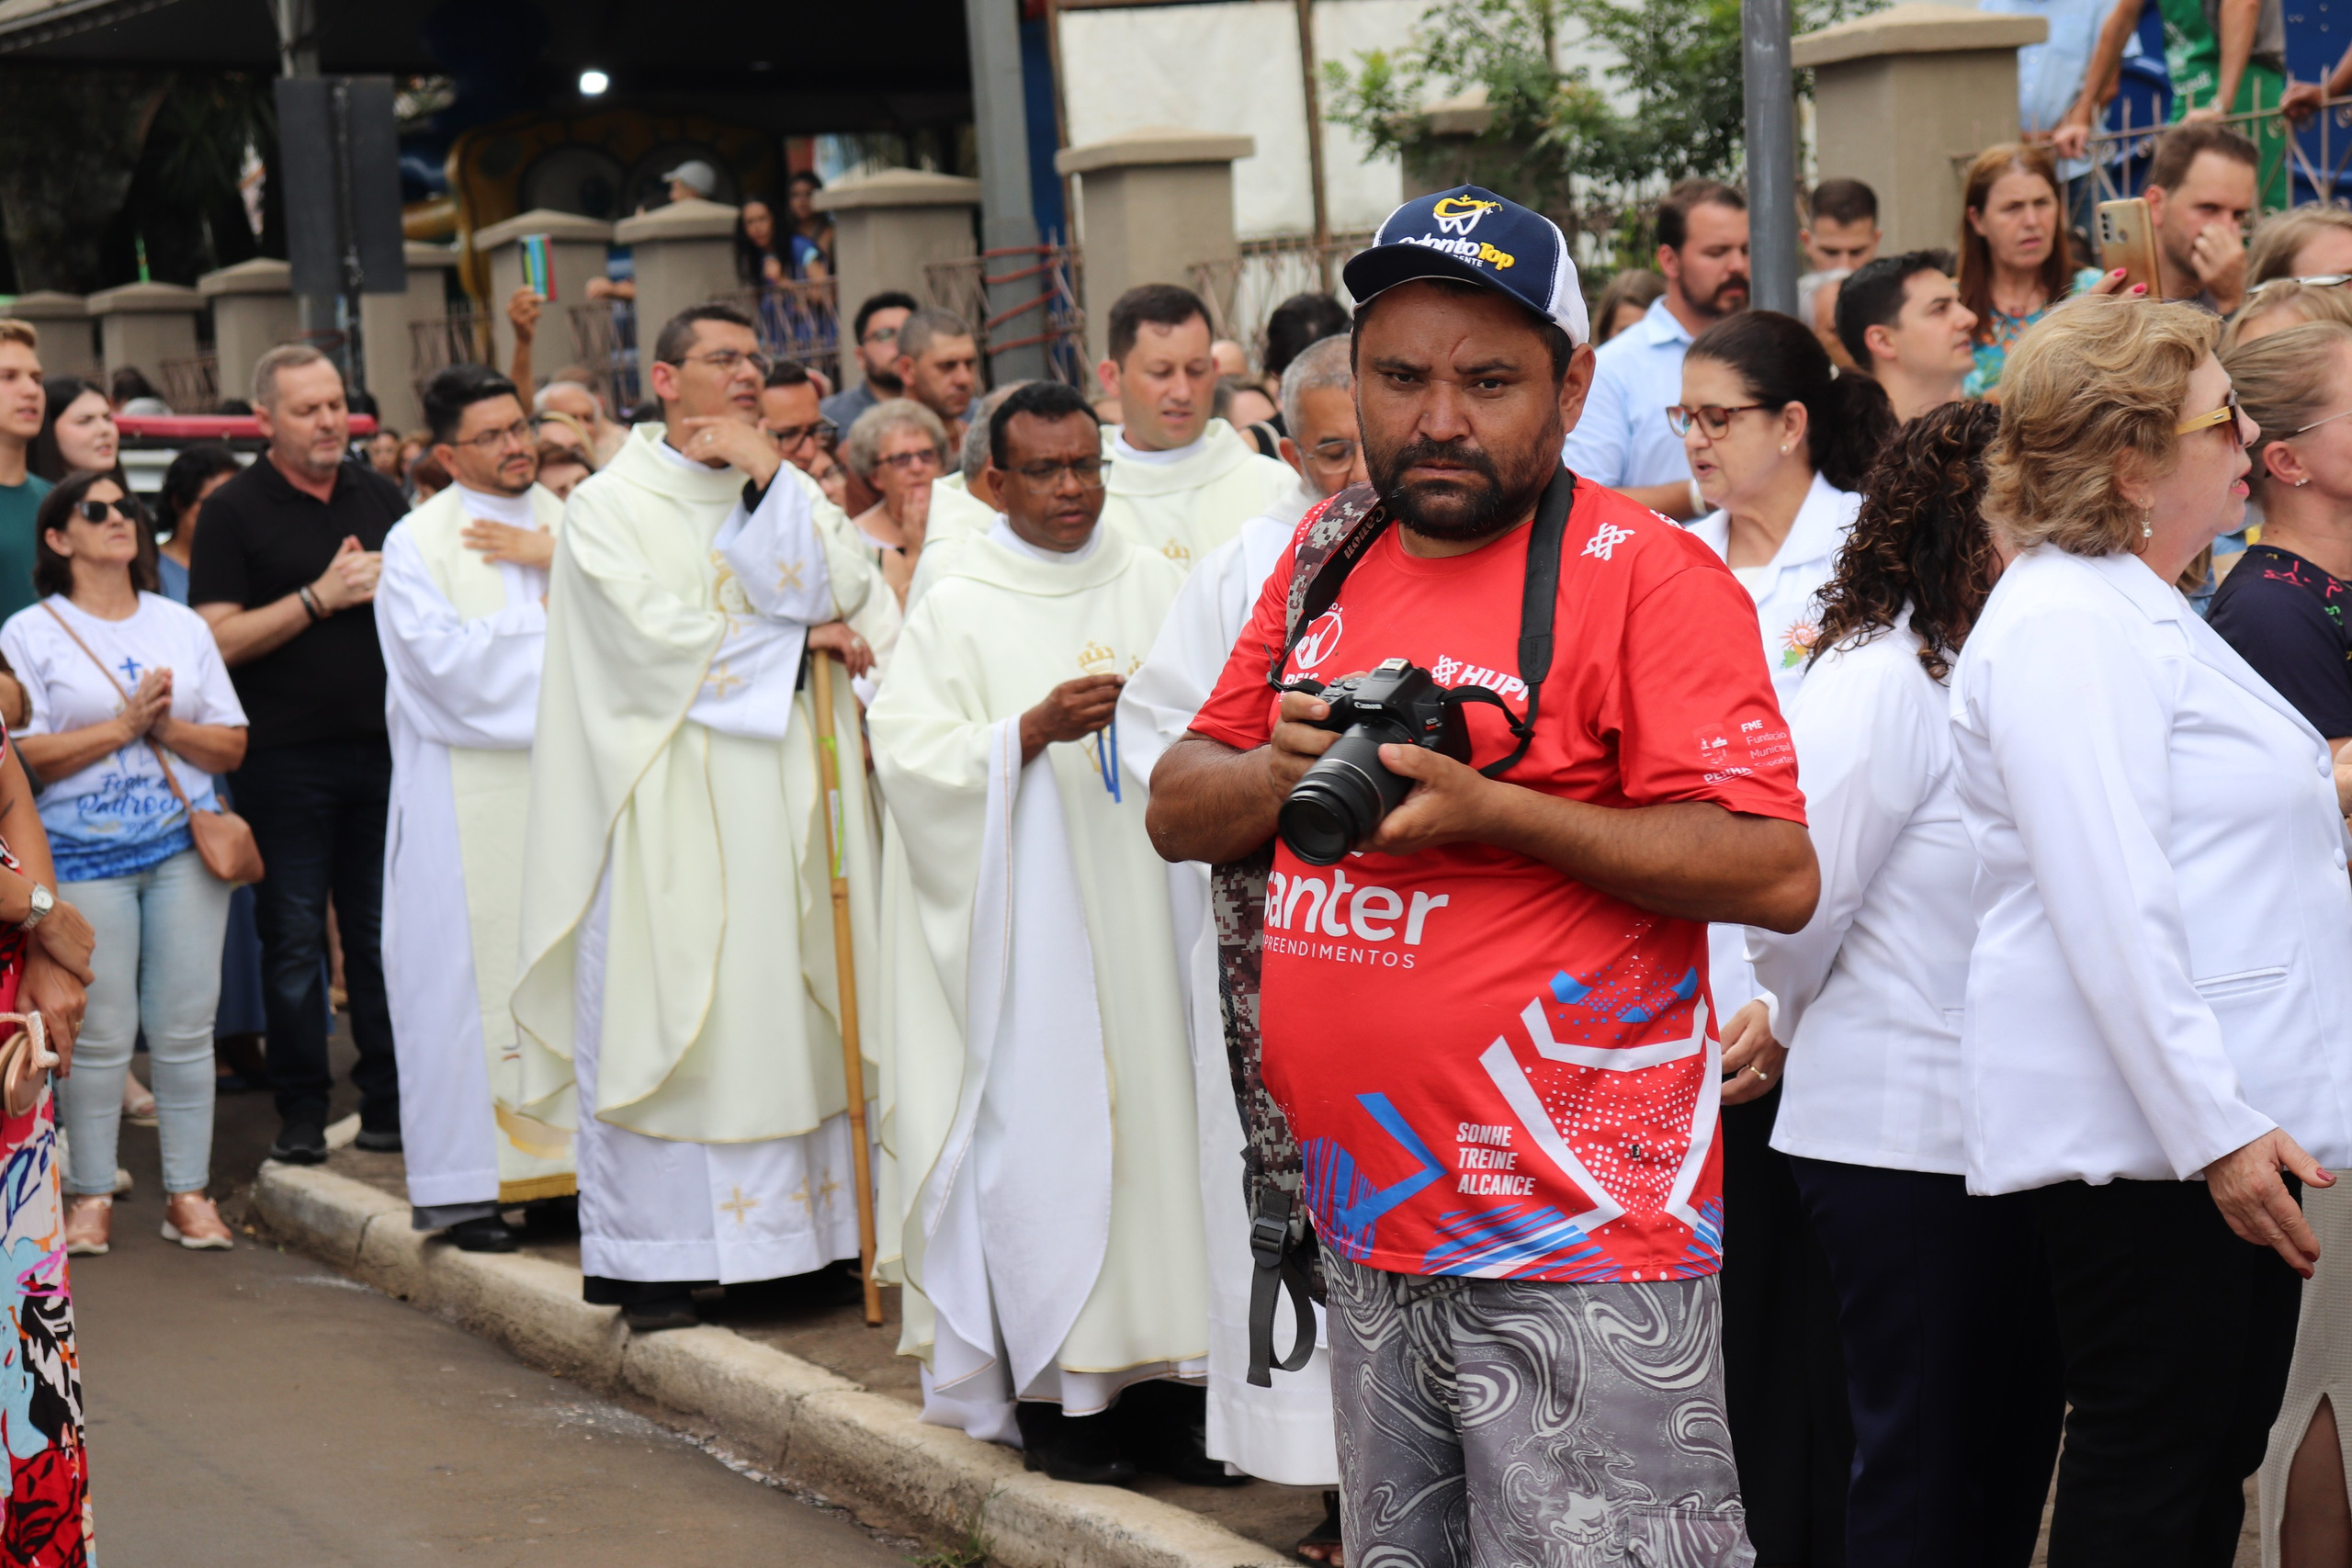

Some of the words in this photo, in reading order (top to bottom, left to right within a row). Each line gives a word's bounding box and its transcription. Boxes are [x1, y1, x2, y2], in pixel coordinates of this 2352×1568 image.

[1397, 232, 1515, 271] dontoTop
[1452, 254, 1484, 267] ENTE
[1343, 505, 1386, 559] Canon
[1740, 719, 1763, 733] FME
[1263, 933, 1416, 970] PREENDIMENTOS
[1455, 1122, 1513, 1147] SONHE
[1458, 1147, 1520, 1171] TREINE
[1456, 1174, 1537, 1196] ALCANCE
